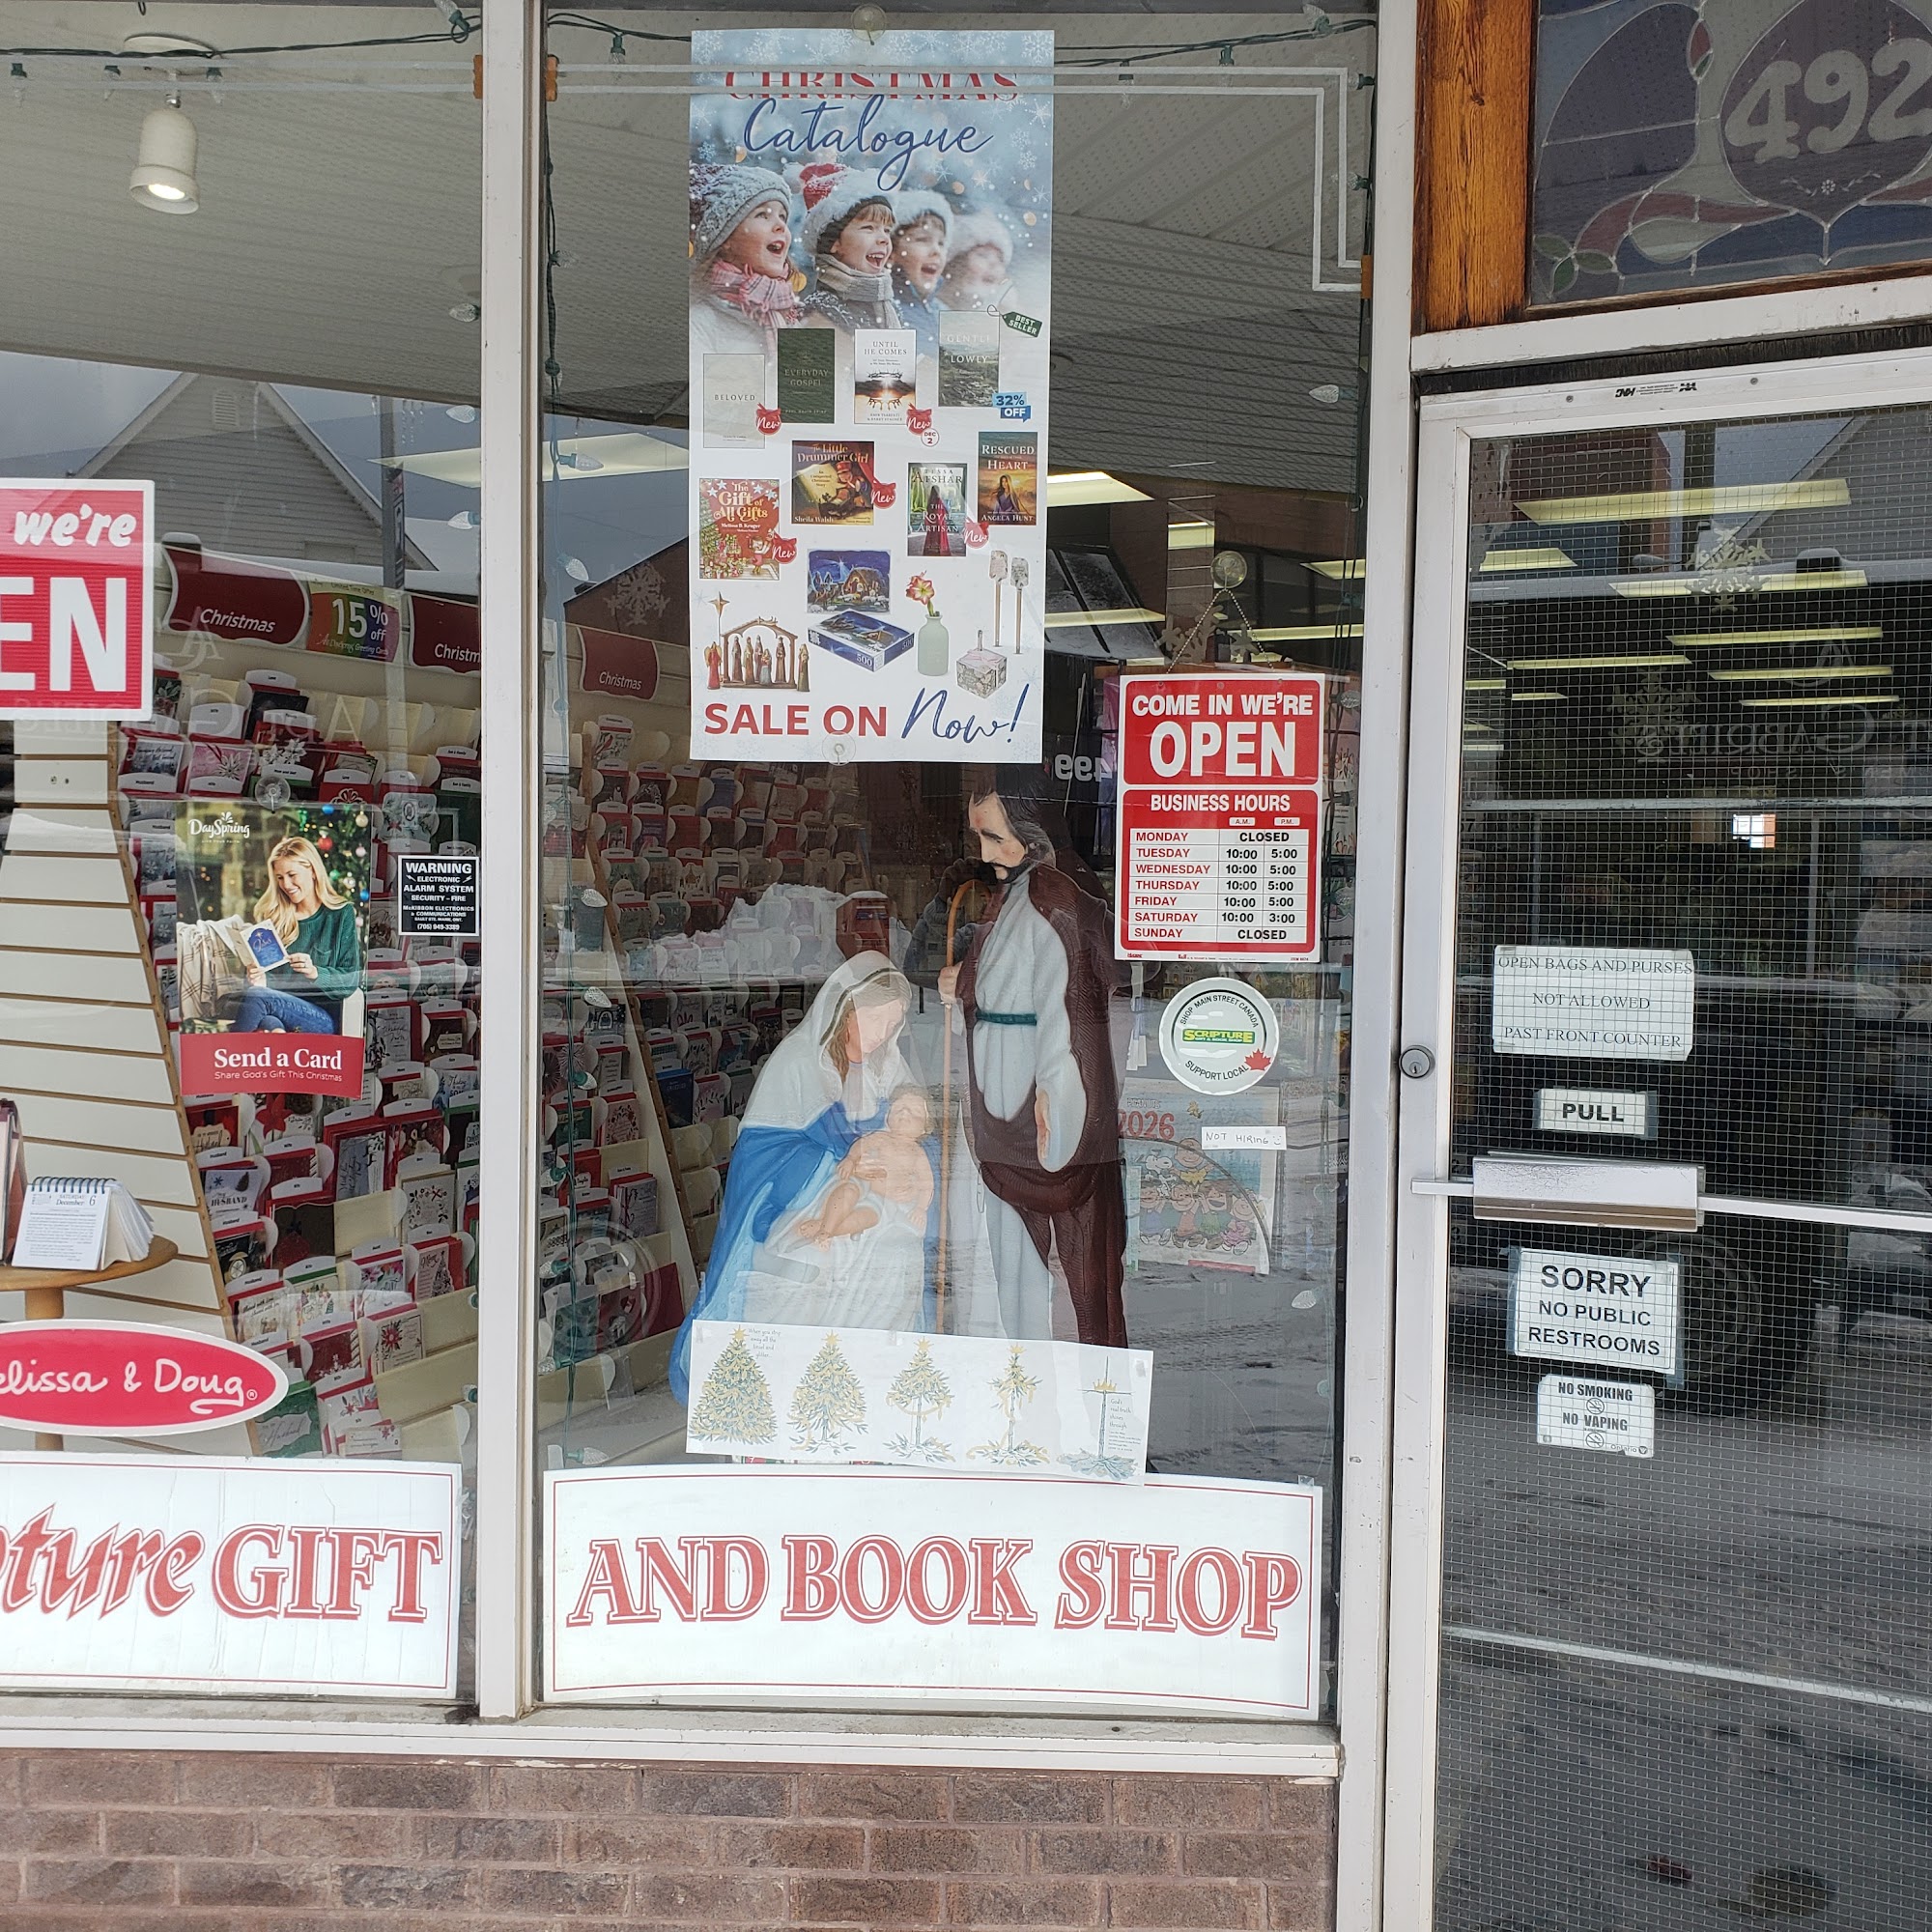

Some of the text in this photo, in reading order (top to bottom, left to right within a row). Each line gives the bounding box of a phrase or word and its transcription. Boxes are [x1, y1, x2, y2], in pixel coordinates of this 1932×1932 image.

[1724, 38, 1932, 164] 492
[743, 94, 994, 191] Catalogue
[1009, 320, 1037, 334] SELLER
[1015, 315, 1035, 326] BEST
[996, 395, 1025, 406] 32%
[1005, 408, 1026, 417] OFF
[756, 415, 781, 429] New
[908, 417, 930, 429] New
[823, 444, 847, 453] Little
[981, 445, 1035, 454] RESCUED
[798, 453, 868, 463] Drummer Girl
[988, 460, 1028, 469] HEART
[913, 471, 962, 483] AFSHAR
[732, 482, 749, 491] The
[719, 492, 753, 506] Gift
[870, 492, 895, 503] New
[714, 506, 768, 522] All Gifts
[923, 511, 953, 524] ROYAL
[14, 503, 136, 547] we're
[917, 524, 958, 532] ARTISAN
[963, 528, 987, 544] New
[773, 546, 796, 558] New
[200, 609, 275, 634] Christmas
[332, 599, 388, 639] 15%
[0, 577, 127, 692] EN
[371, 629, 386, 641] off
[435, 643, 480, 663] Christm
[856, 653, 873, 667] 500
[599, 671, 642, 691] Christmas
[1132, 693, 1313, 716] COME IN WE'RE
[704, 683, 1029, 743] SALE ON Now!
[1150, 721, 1295, 778] OPEN
[1151, 794, 1291, 811] BUSINESS HOURS
[188, 818, 250, 838] DaySpring
[1136, 832, 1290, 842] MONDAY CLOSED
[1136, 848, 1297, 860] TUESDAY 10:00 5:00
[406, 863, 471, 874] WARNING
[1136, 865, 1296, 875] WEDNESDAY 10:00 5:00
[1136, 881, 1293, 891] THURSDAY 10:00 5:00
[1135, 896, 1293, 907] FRIDAY 10:00 5:00
[1135, 913, 1295, 923] SATURDAY 10:00 3:00
[1135, 928, 1287, 940] SUNDAY CLOSED
[1498, 956, 1692, 975] OPEN BAGS AND PURSES
[1532, 993, 1650, 1009] NOT ALLOWED
[1180, 995, 1259, 1028] SHOP MAIN STREET CANADA
[1184, 1030, 1253, 1042] SCRIPTURE
[1505, 1028, 1681, 1047] PAST FRONT COUNTER
[214, 1047, 342, 1070] Send a Card
[242, 1070, 267, 1079] God's
[306, 1071, 342, 1082] Christmas
[1185, 1061, 1249, 1080] SUPPORT LOCAL
[1562, 1103, 1624, 1122] PULL
[1118, 1109, 1175, 1140] 2026
[1207, 1132, 1227, 1141] NOT
[89, 1195, 97, 1206] 6
[1541, 1265, 1652, 1298] SORRY
[1539, 1300, 1652, 1326] NO PUBLIC
[1529, 1326, 1660, 1355] RESTROOMS
[124, 1362, 142, 1390] &
[155, 1359, 243, 1414] Doug
[1558, 1382, 1633, 1402] NO SMOKING
[1563, 1412, 1628, 1431] NO VAPING
[0, 1502, 442, 1623] ture GIFT
[566, 1534, 1303, 1639] AND BOOK SHOP
